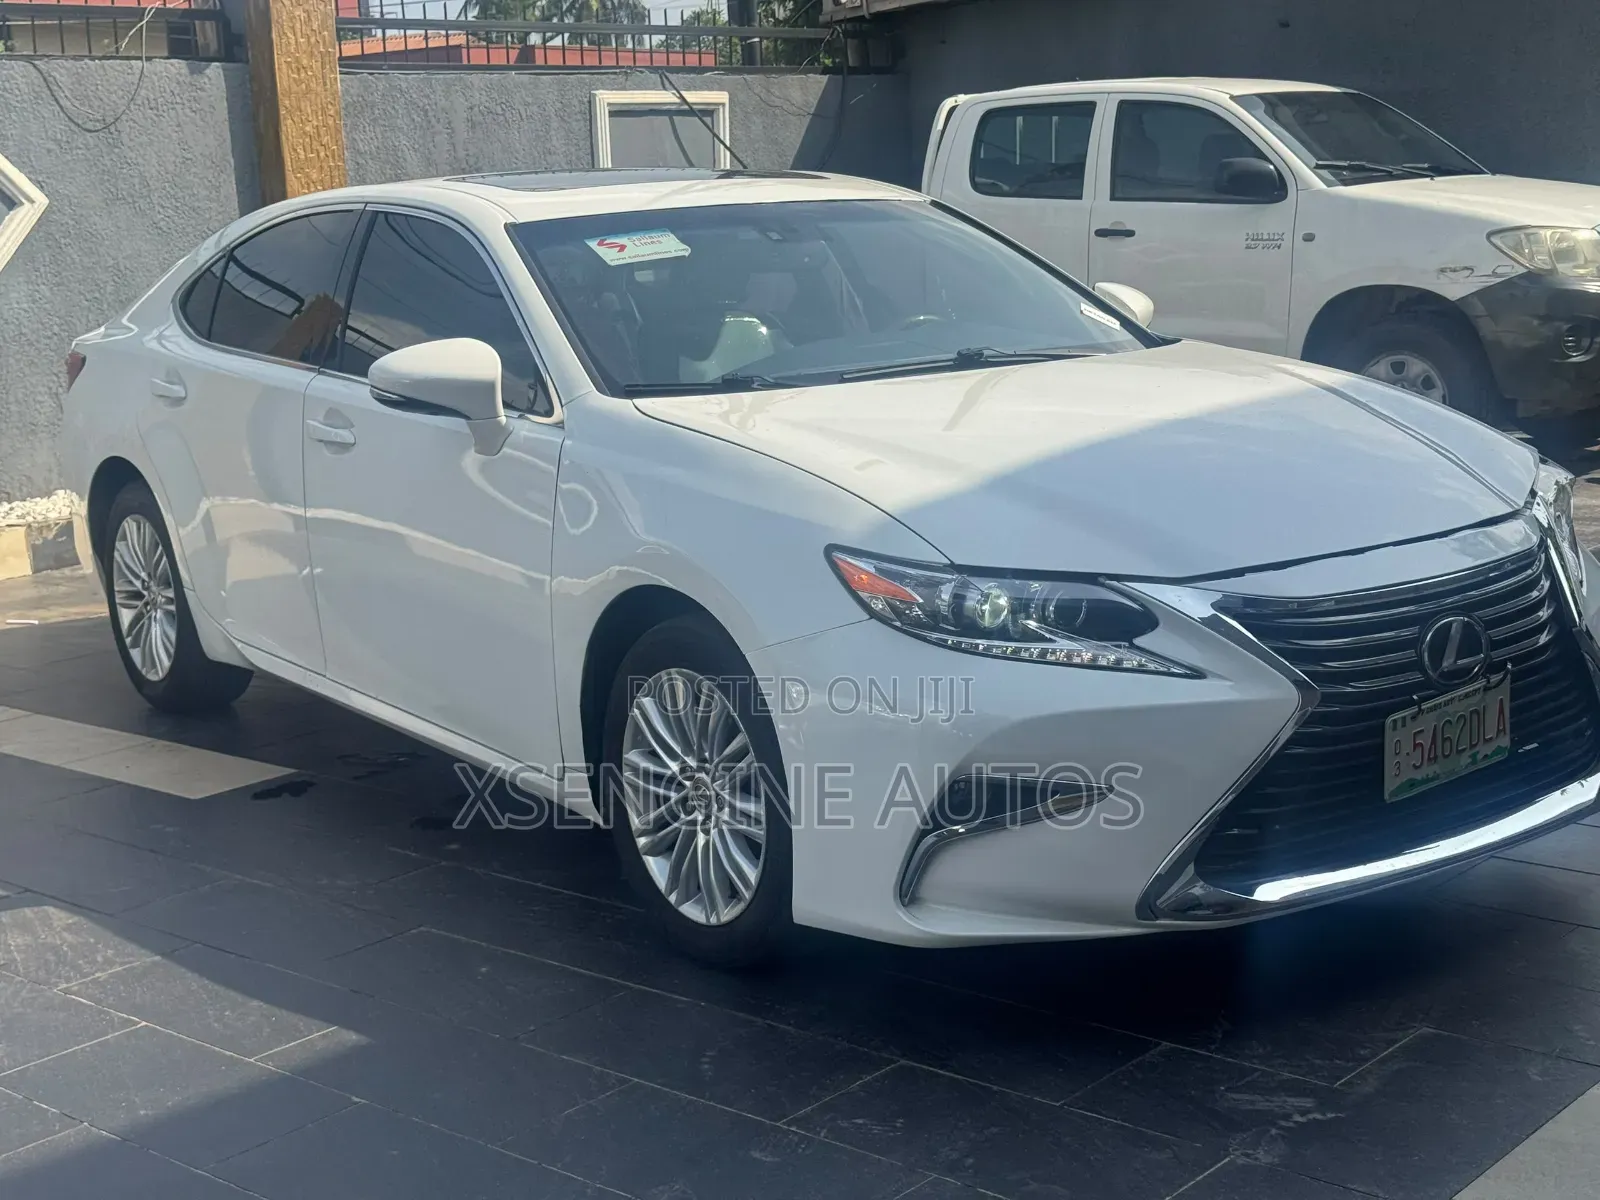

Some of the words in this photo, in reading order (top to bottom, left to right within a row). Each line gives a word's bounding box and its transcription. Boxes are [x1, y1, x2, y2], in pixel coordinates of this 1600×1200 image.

[627, 233, 671, 242] Sallaum
[1244, 232, 1285, 241] HILUX
[632, 239, 664, 248] Lines
[1411, 696, 1507, 770] 5462DLA
